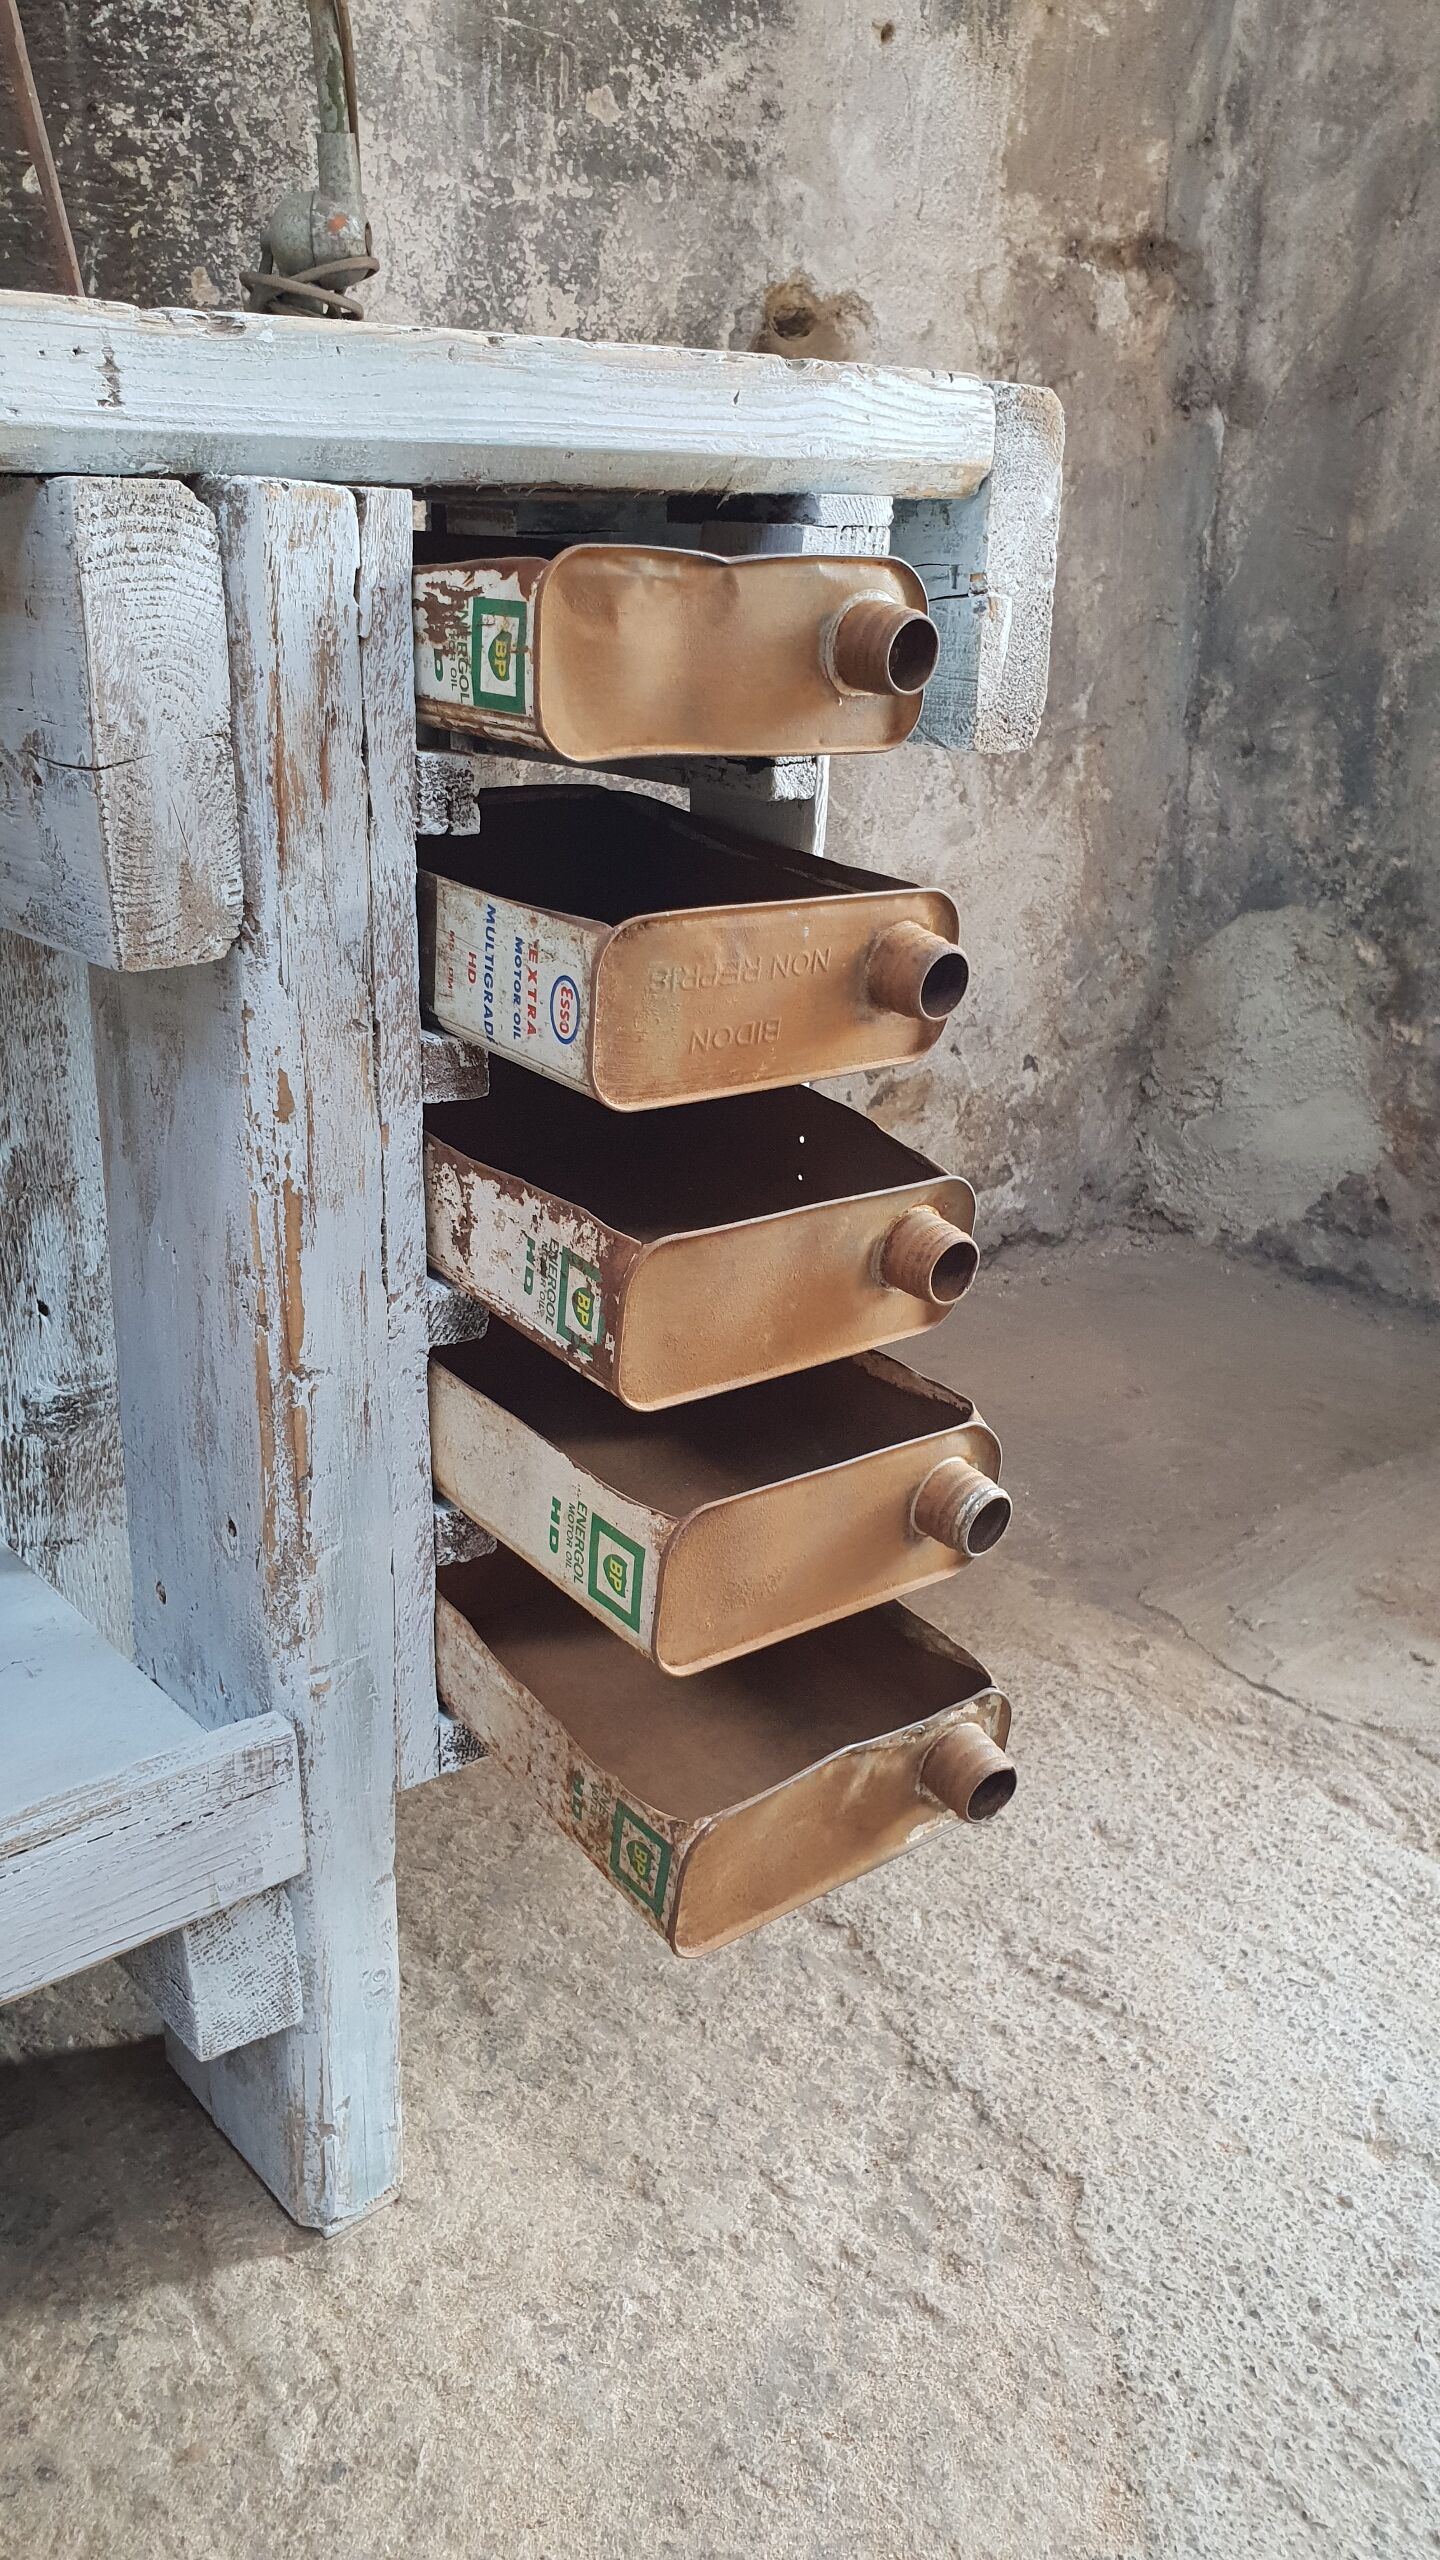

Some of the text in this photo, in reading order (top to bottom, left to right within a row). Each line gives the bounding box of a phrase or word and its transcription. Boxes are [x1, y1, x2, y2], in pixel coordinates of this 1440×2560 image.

[496, 640, 506, 676] BP
[450, 668, 458, 691] OIL
[467, 951, 477, 985] HD
[770, 947, 832, 980] NON
[512, 937, 524, 1040] MOTOR OIL
[527, 949, 539, 1035] EXTRA
[560, 986, 573, 1034] ESSO
[689, 1016, 783, 1055] BIDON
[524, 1237, 535, 1295] HD
[577, 1291, 588, 1326] BP
[550, 1495, 562, 1554] HD
[565, 1502, 575, 1569] MOTOR OIL
[574, 1501, 587, 1584] ENERGOL
[609, 1558, 622, 1591] BP
[633, 1845, 647, 1876] BP
